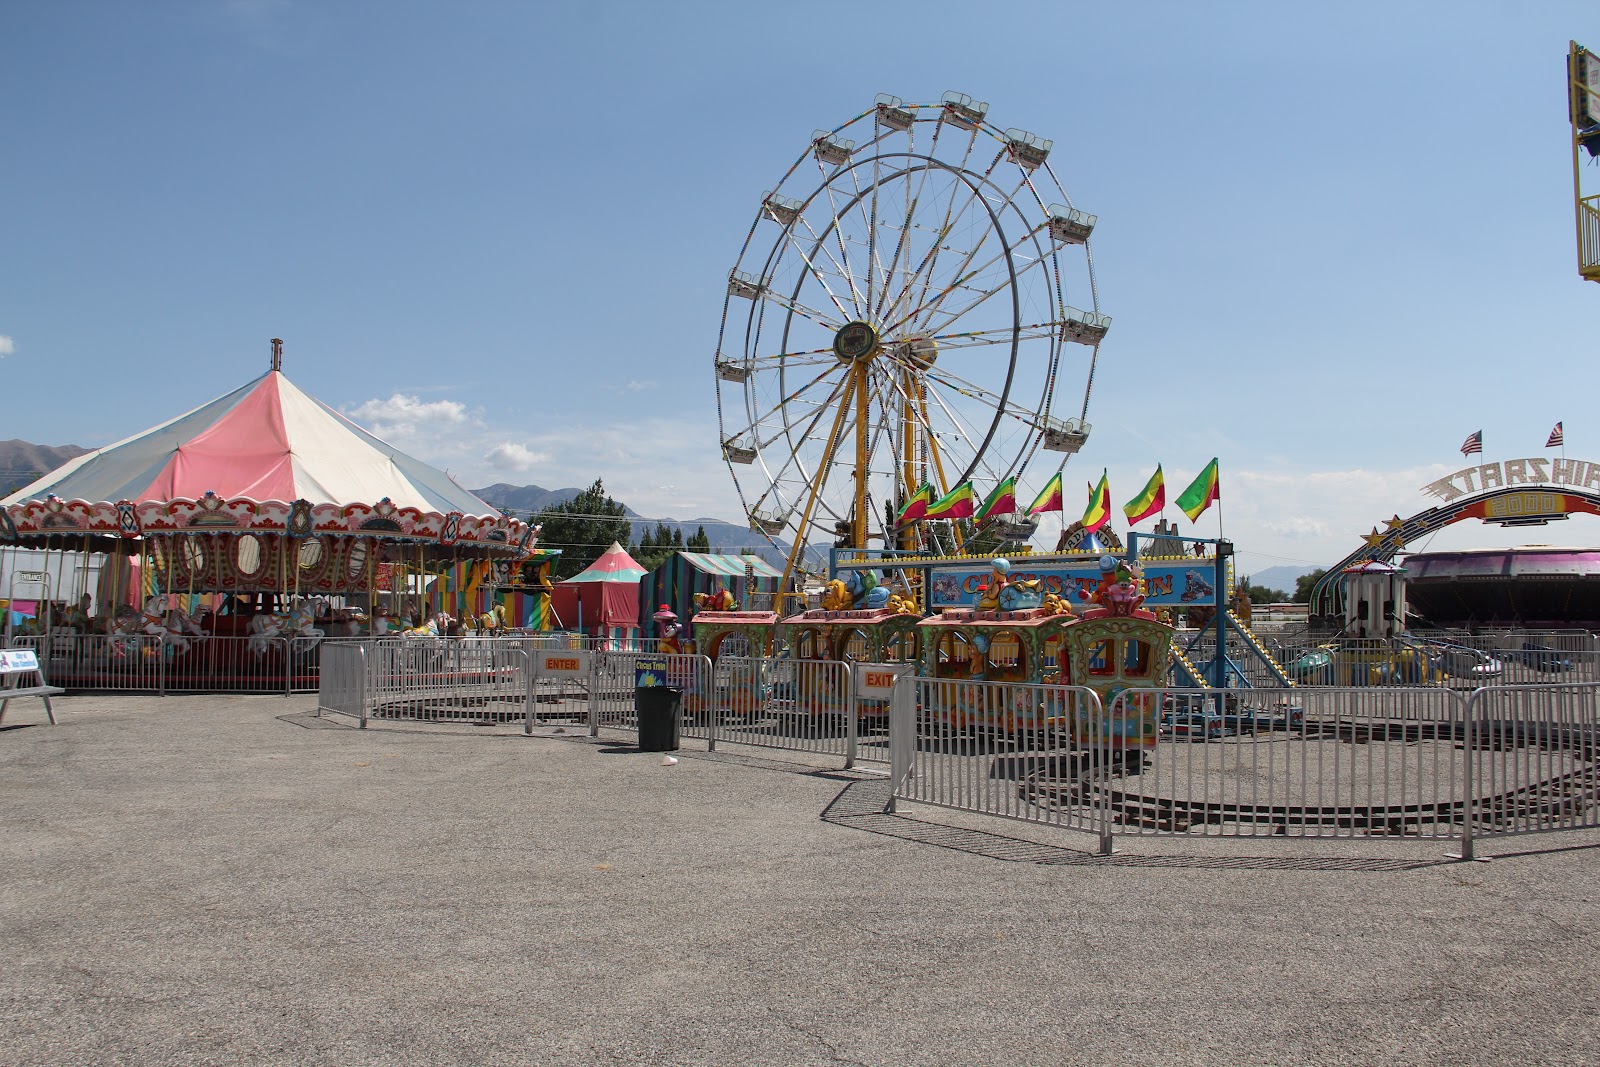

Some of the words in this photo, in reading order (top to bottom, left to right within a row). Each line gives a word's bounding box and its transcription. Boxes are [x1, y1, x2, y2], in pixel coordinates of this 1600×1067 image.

[1492, 494, 1555, 517] 2000
[547, 659, 577, 669] ENTER
[636, 661, 652, 669] Circus
[653, 662, 666, 670] Train
[867, 673, 893, 686] EXIT
